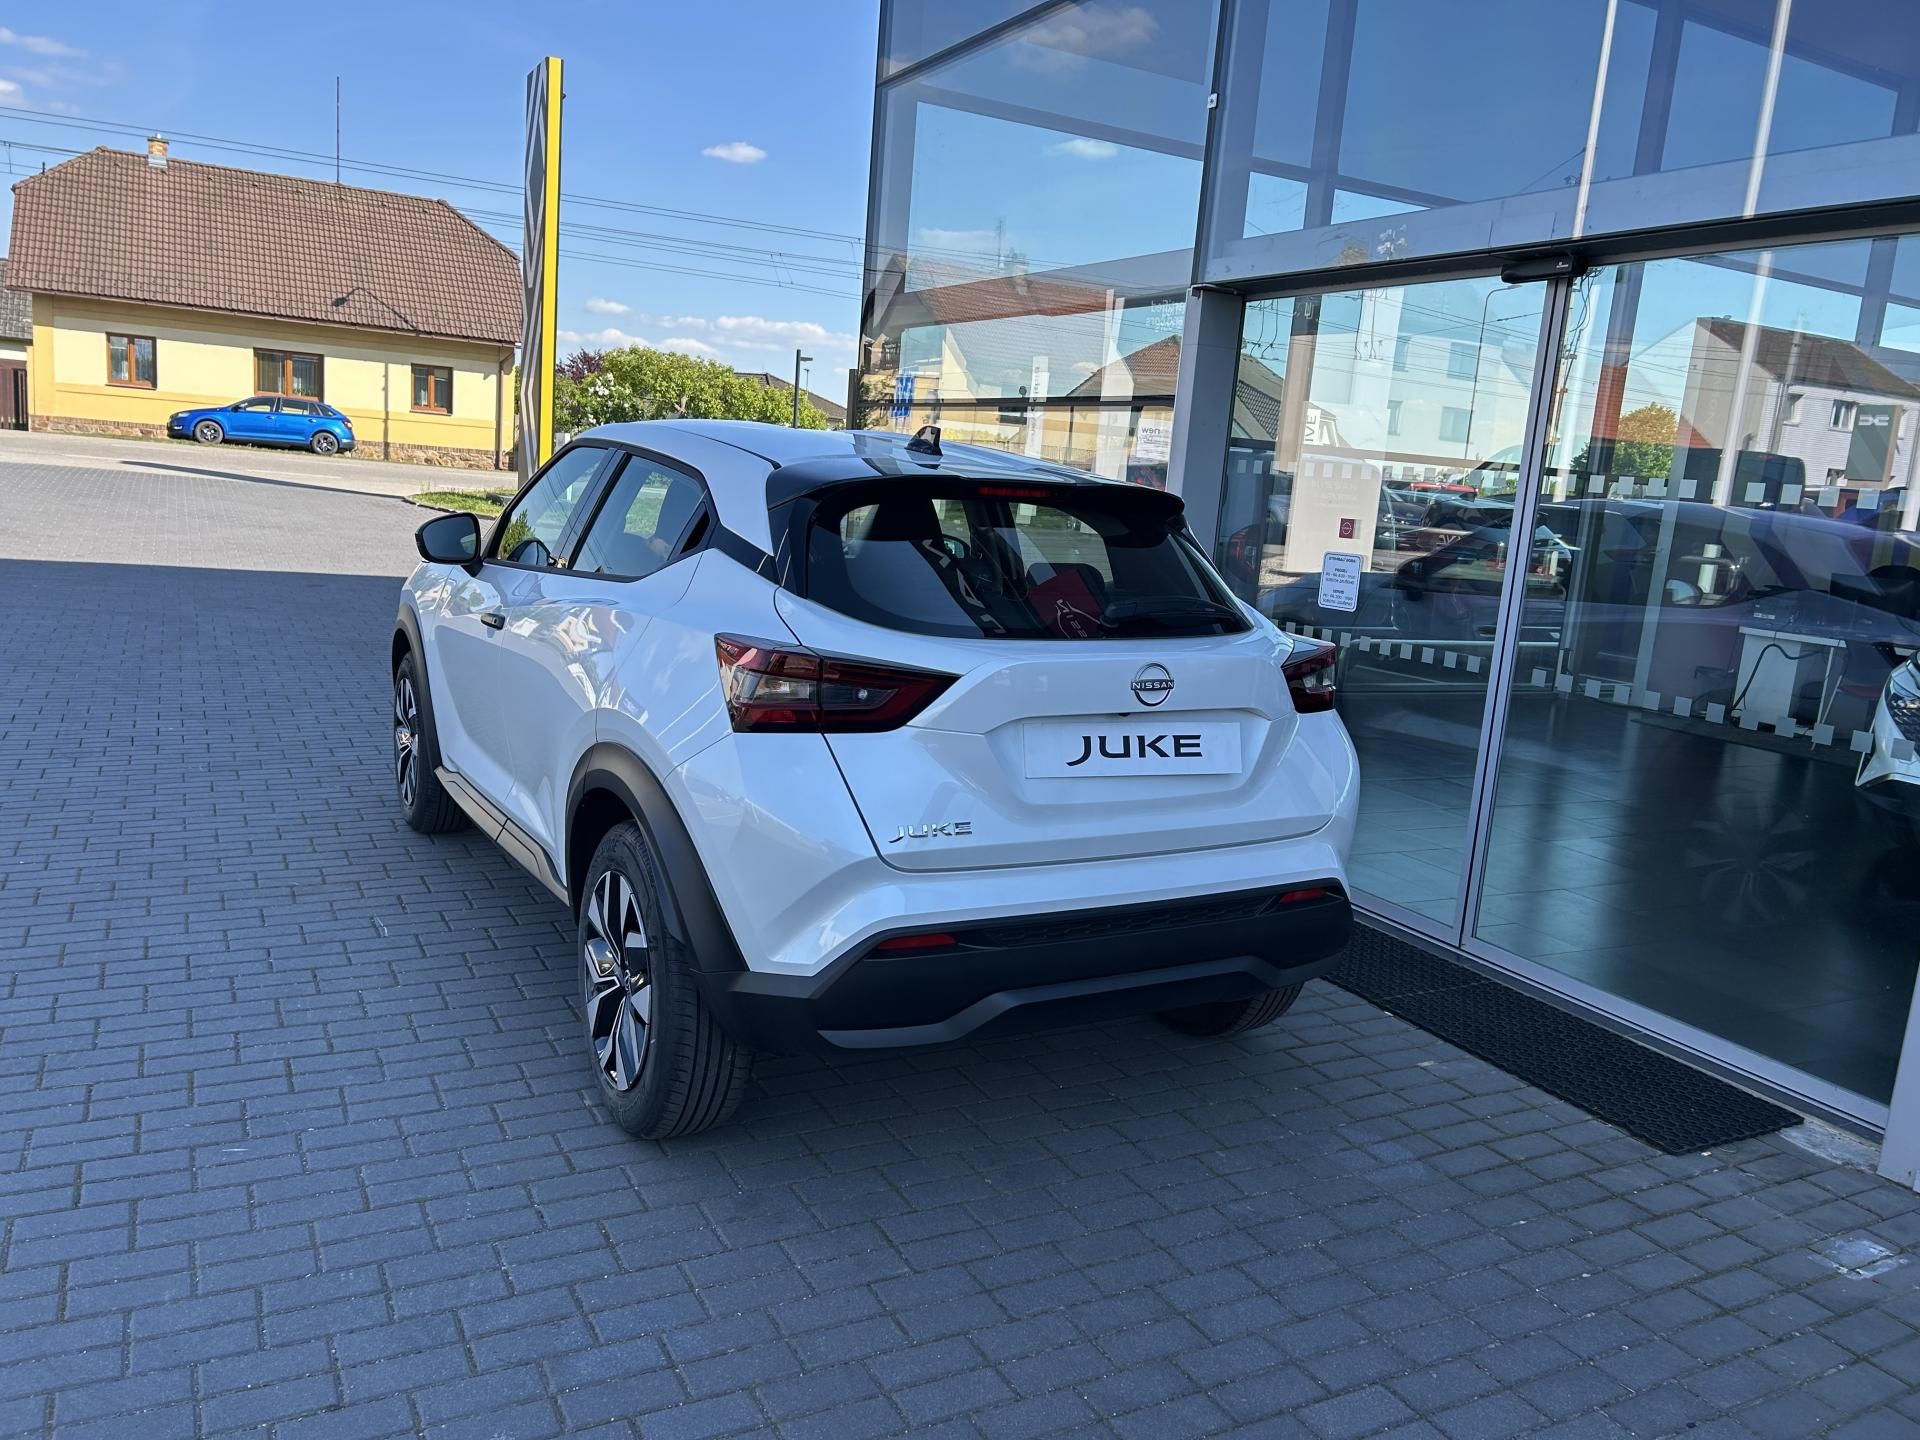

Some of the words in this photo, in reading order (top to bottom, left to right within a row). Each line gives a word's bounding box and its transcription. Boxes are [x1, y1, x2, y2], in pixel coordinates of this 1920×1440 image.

[1132, 681, 1174, 689] NISSAN
[1066, 734, 1203, 767] JUKE
[888, 821, 973, 843] JUKE
